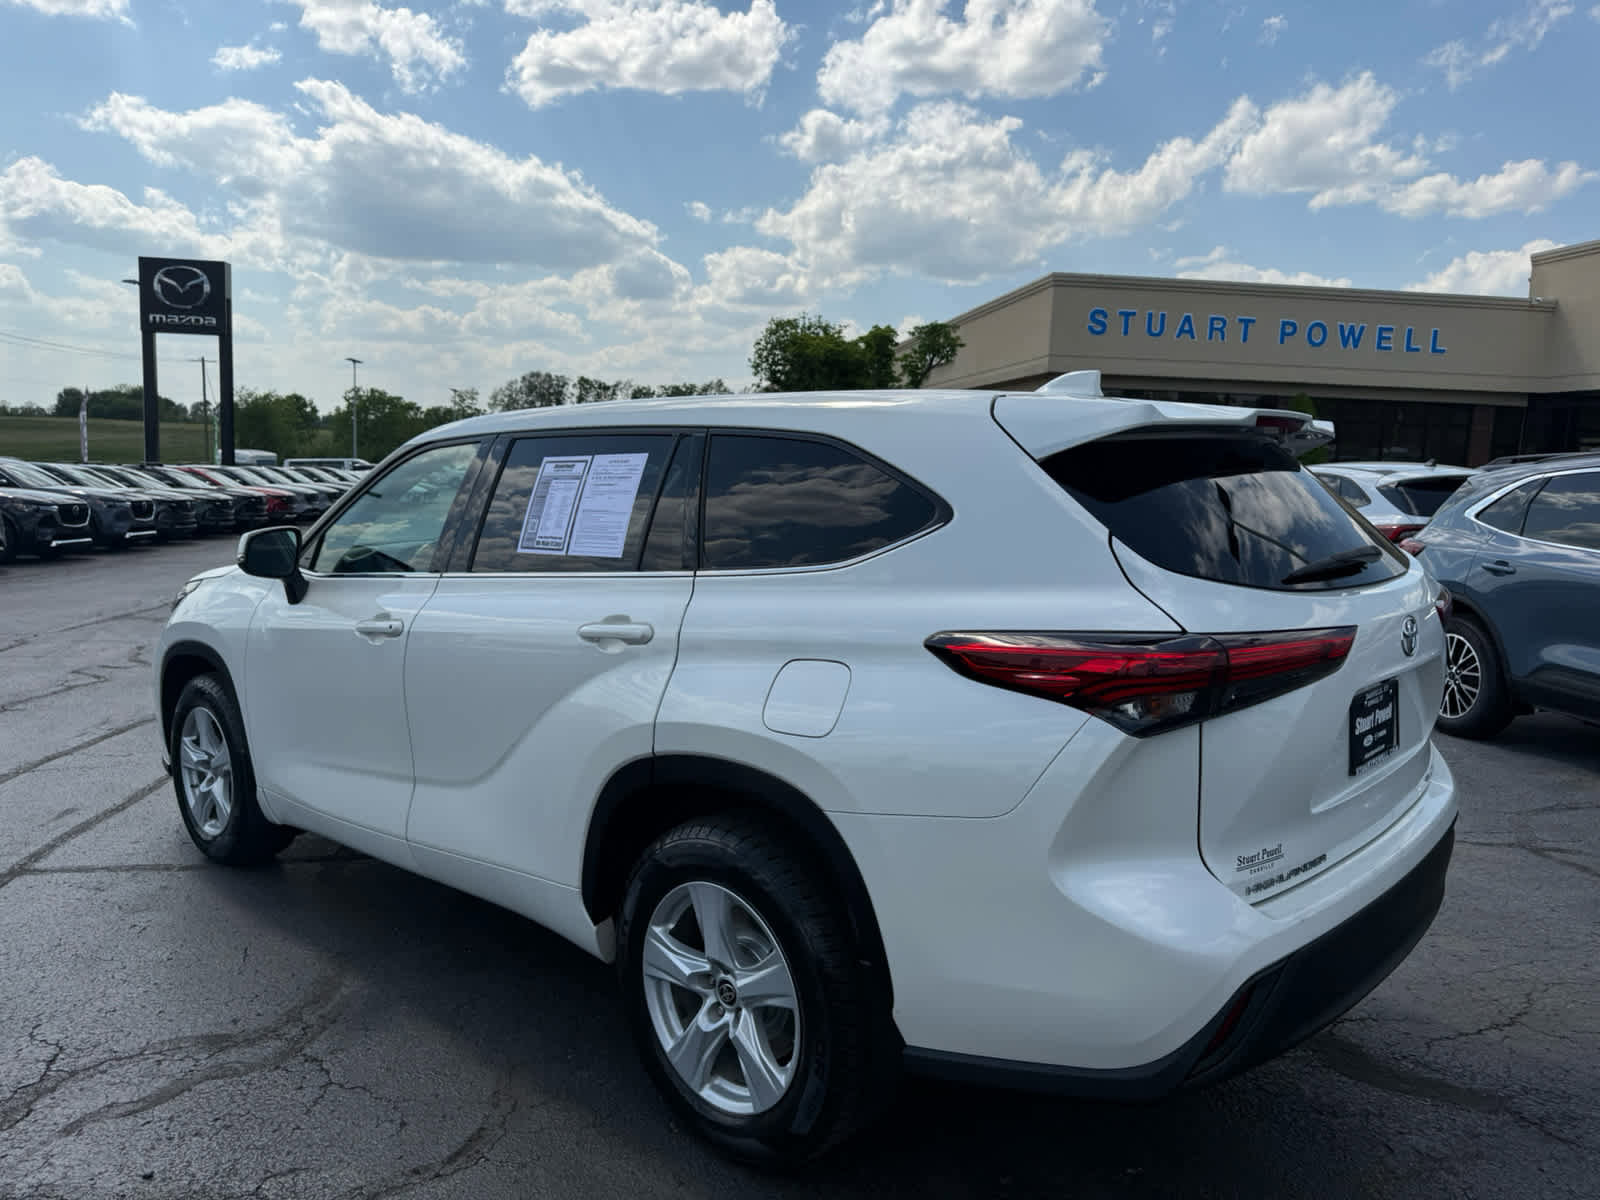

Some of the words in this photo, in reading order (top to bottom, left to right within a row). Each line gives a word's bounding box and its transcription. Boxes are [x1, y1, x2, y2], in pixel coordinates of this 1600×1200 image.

[1087, 307, 1257, 344] STUART
[1278, 319, 1448, 354] POWELL
[1355, 711, 1375, 736] Stuart
[1375, 701, 1393, 726] Powell
[1236, 852, 1260, 868] Stuart
[1262, 843, 1283, 860] Powell
[1245, 853, 1328, 896] HIGHLANDER
